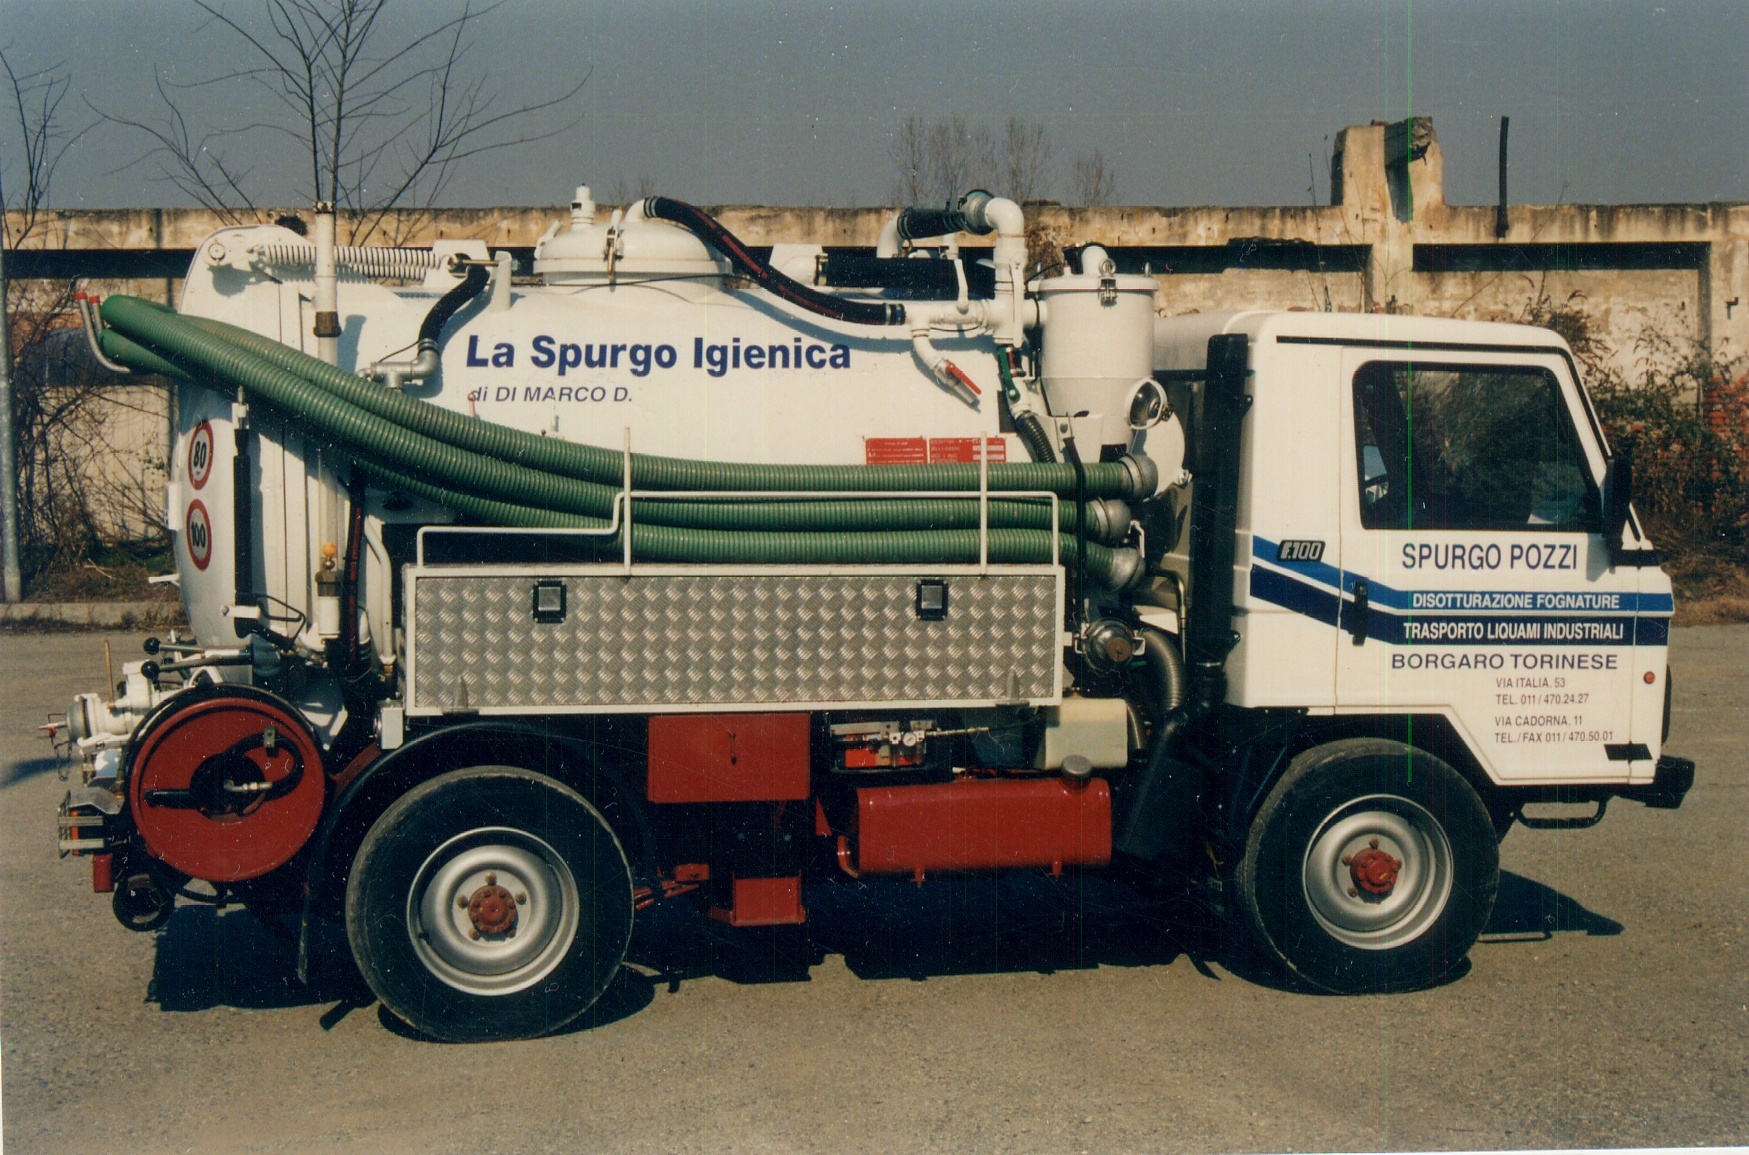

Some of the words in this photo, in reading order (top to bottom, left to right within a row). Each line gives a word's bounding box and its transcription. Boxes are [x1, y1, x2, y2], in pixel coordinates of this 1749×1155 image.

[467, 335, 514, 367] La
[530, 335, 677, 377] Spurgo
[693, 337, 851, 378] Igienica
[470, 386, 488, 402] di
[495, 386, 516, 402] DI
[523, 386, 606, 402] MARCO
[613, 386, 632, 402] D.
[193, 440, 207, 470] 80
[190, 522, 206, 549] 100
[1402, 544, 1502, 570] SPURGO
[1510, 544, 1578, 570] POZZI
[1412, 593, 1533, 609] DISOTTURAZIONE
[1536, 594, 1620, 609] FOGNATURE
[1403, 622, 1484, 639] TRASPORTO
[1487, 623, 1541, 640] LIQUAMI
[1544, 623, 1624, 640] INDUSTRIALI
[1391, 653, 1505, 670] BORGARO
[1509, 653, 1618, 670] TORINESE
[1496, 677, 1513, 688] VIA
[1554, 677, 1566, 688] 53
[1496, 694, 1518, 705] TEL.
[1495, 716, 1512, 726] VIA
[1574, 715, 1583, 726] 11
